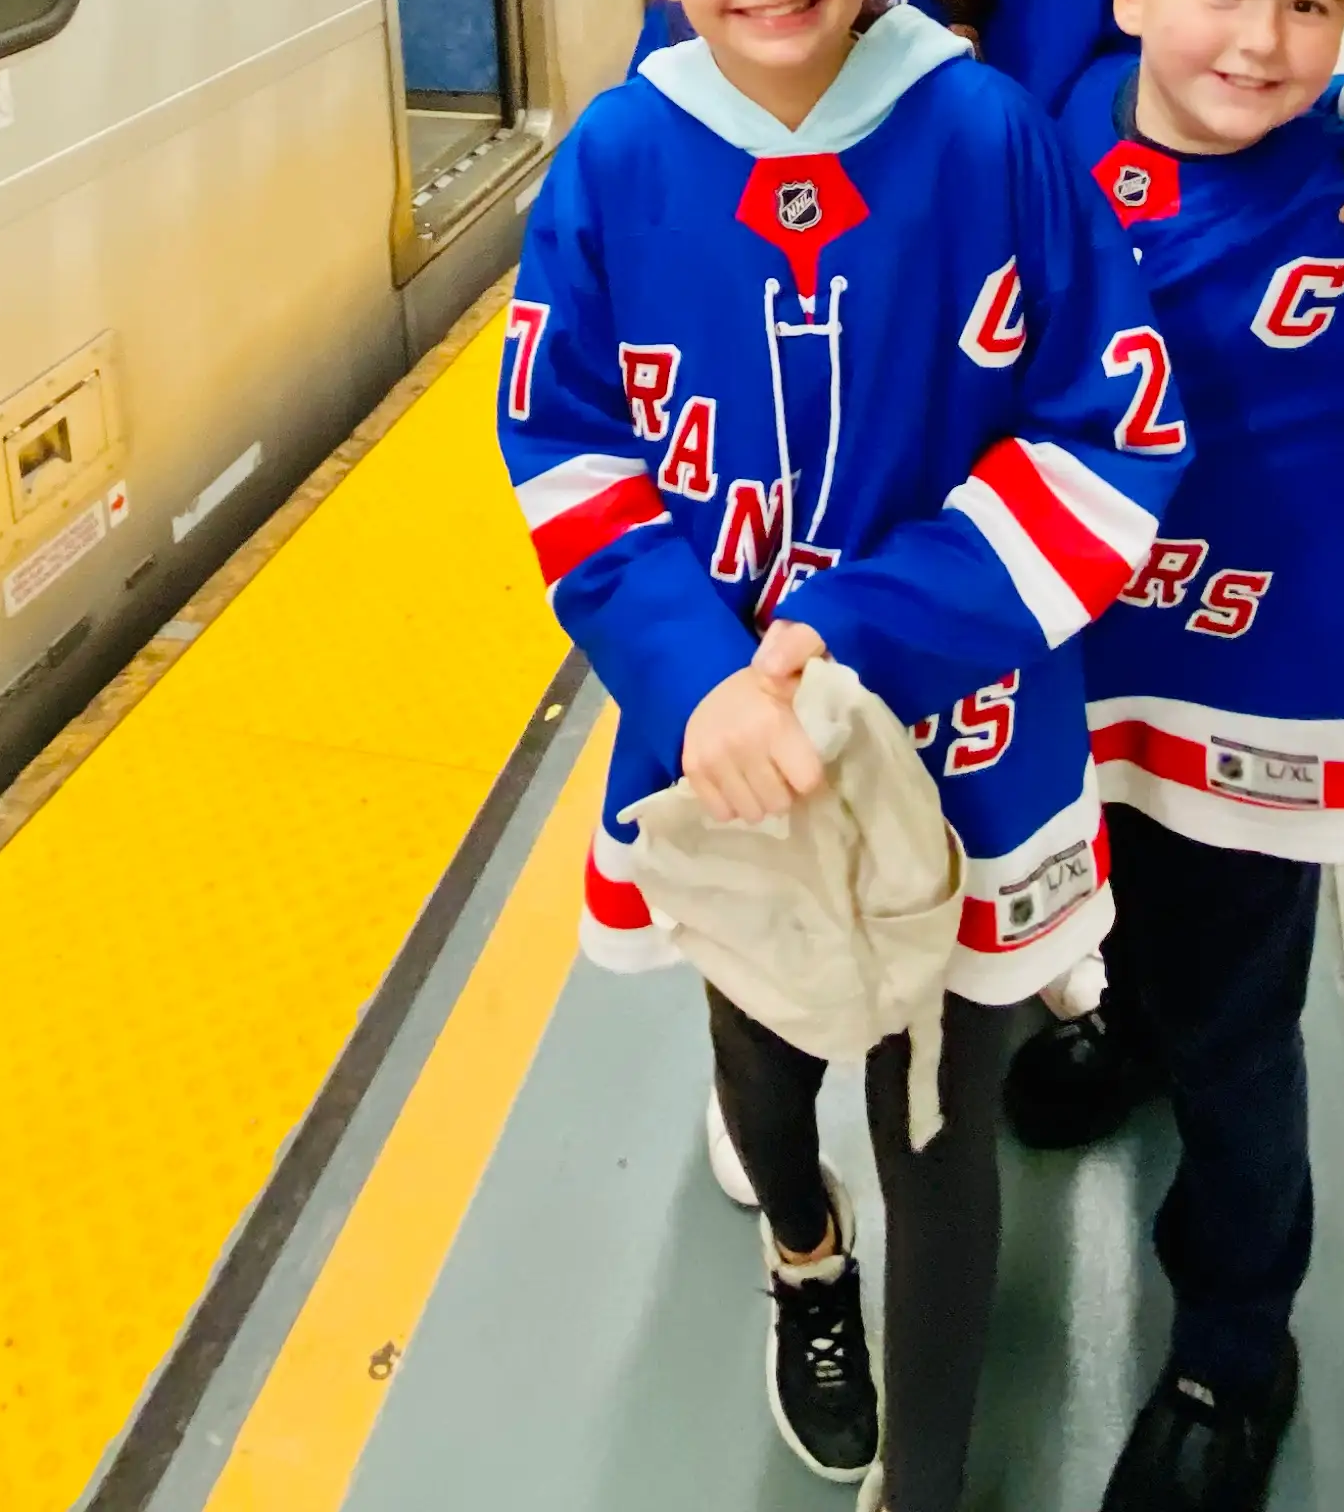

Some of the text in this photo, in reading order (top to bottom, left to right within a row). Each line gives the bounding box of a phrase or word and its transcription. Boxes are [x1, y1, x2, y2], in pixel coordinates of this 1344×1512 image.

[1101, 325, 1186, 456] 2
[1264, 761, 1315, 783] L/XL
[1045, 857, 1089, 892] L/XL
